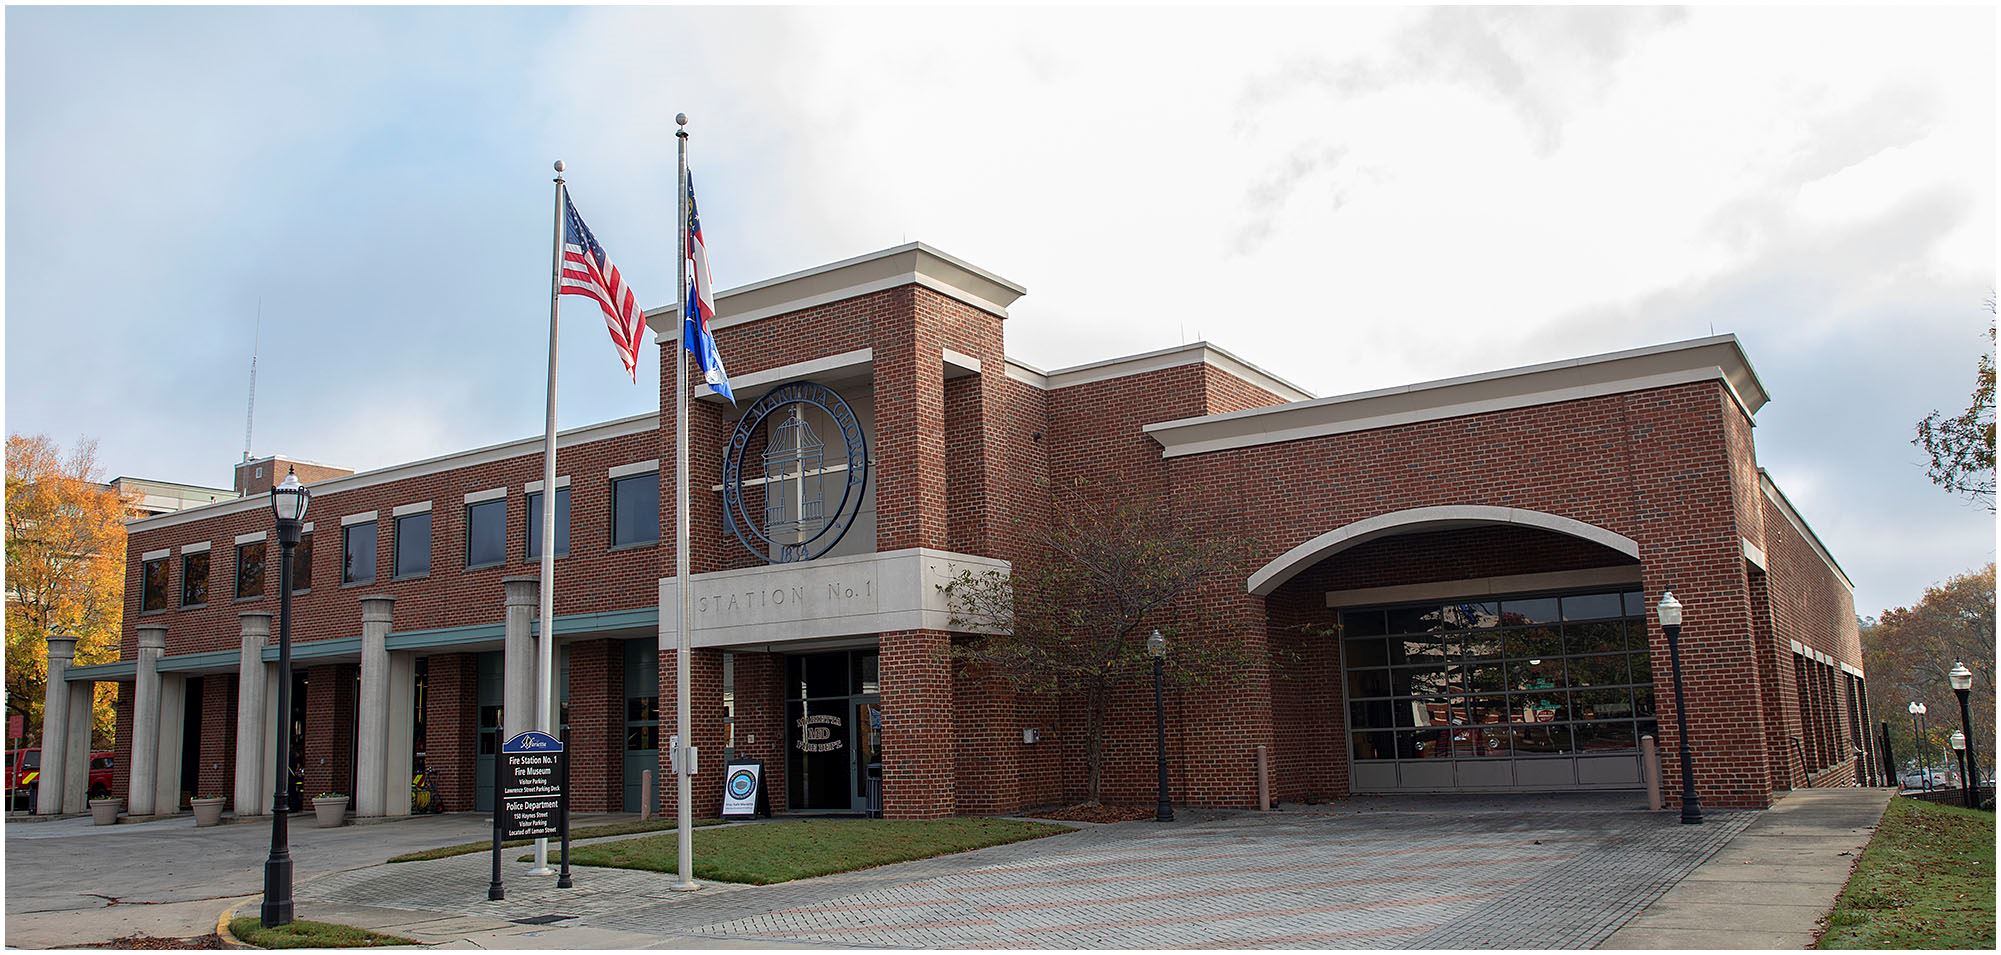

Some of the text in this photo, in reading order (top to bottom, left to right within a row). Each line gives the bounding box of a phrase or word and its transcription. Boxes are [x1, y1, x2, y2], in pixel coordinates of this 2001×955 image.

[733, 422, 752, 450] OF
[753, 384, 829, 420] MARIETTA
[833, 401, 862, 487] GEORGIA
[780, 544, 809, 562] 1834
[698, 580, 872, 614] STATION No. 1
[509, 755, 557, 765] Fire Station No. 1
[515, 767, 551, 776] Fire Museum
[506, 800, 558, 811] Police Department
